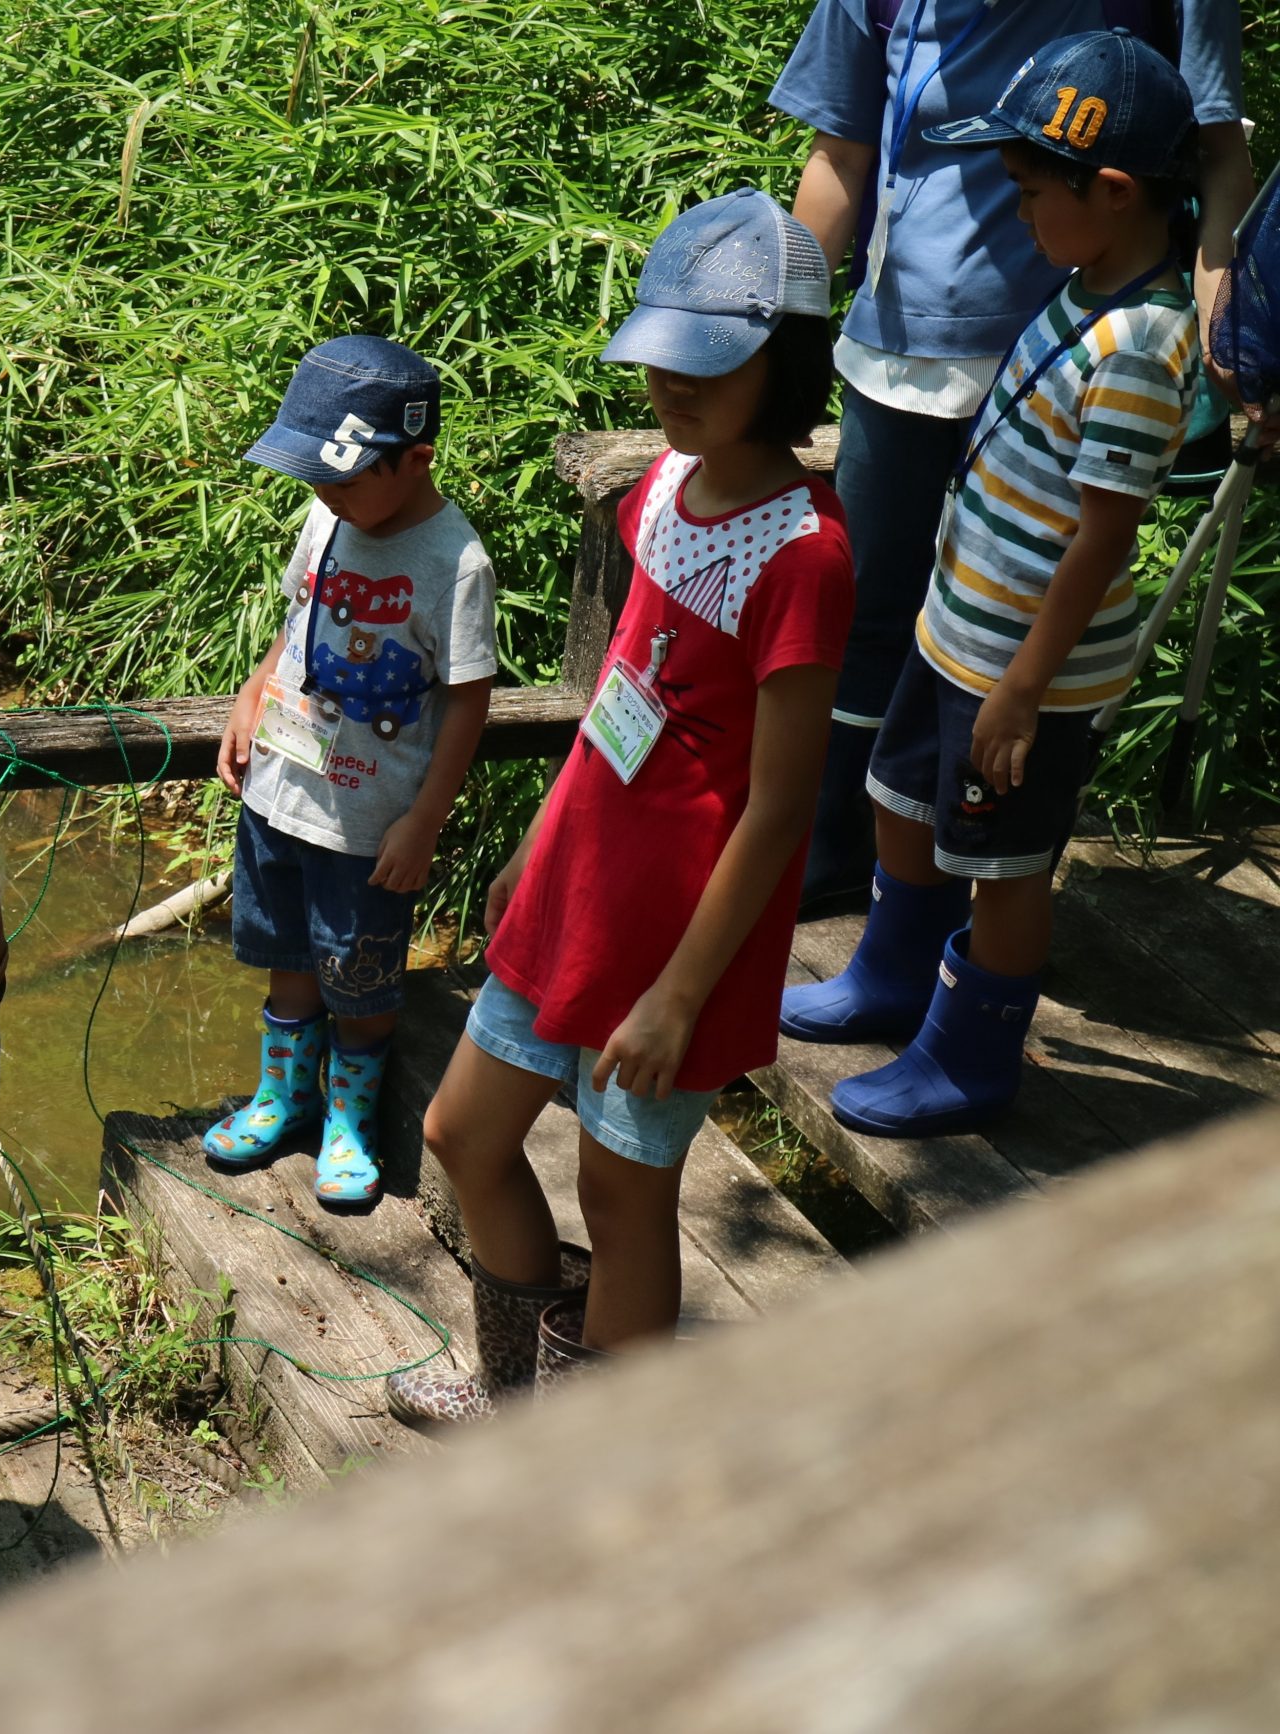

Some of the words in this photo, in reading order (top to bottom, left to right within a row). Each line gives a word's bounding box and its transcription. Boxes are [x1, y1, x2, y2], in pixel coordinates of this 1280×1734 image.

[1042, 86, 1108, 150] 10
[687, 281, 708, 305] of
[320, 412, 376, 472] 5
[323, 769, 360, 789] ace
